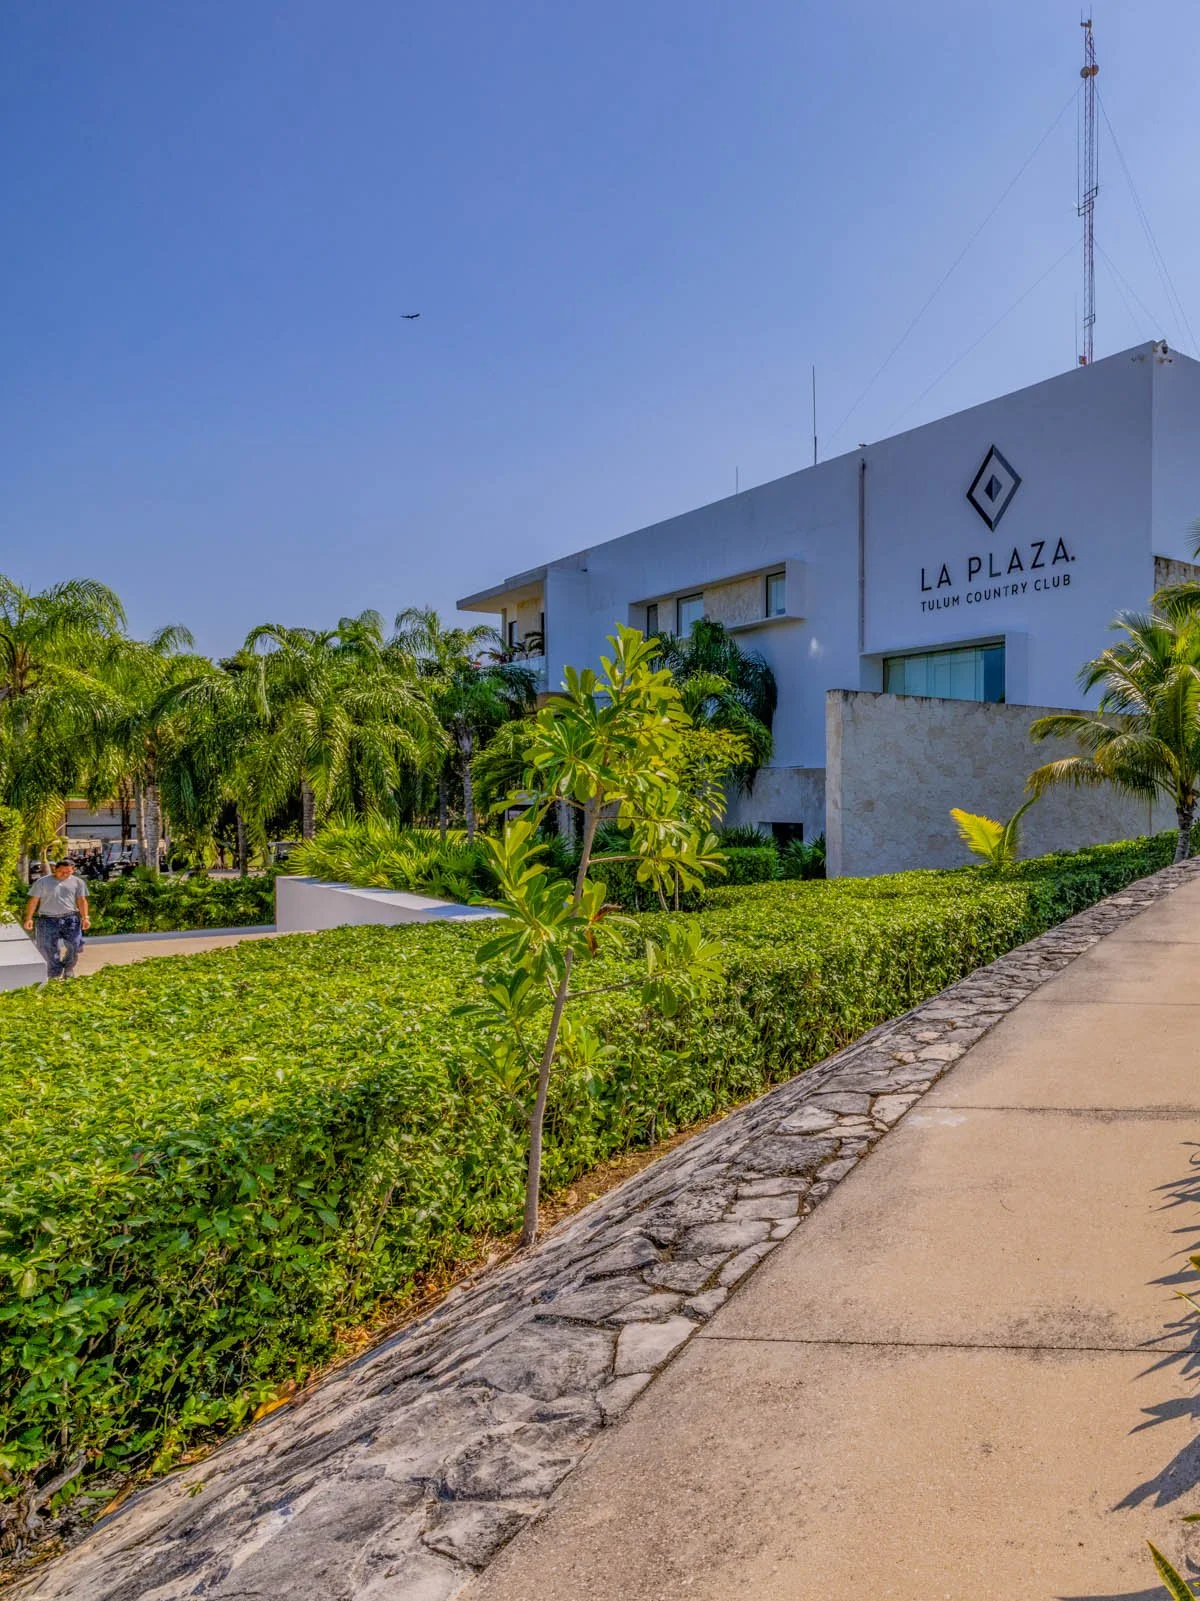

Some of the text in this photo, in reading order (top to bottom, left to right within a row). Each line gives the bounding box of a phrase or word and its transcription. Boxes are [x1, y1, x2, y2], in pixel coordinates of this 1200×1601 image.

[920, 563, 952, 592] LA
[920, 573, 1072, 613] TULUM COUNTRY CLUB
